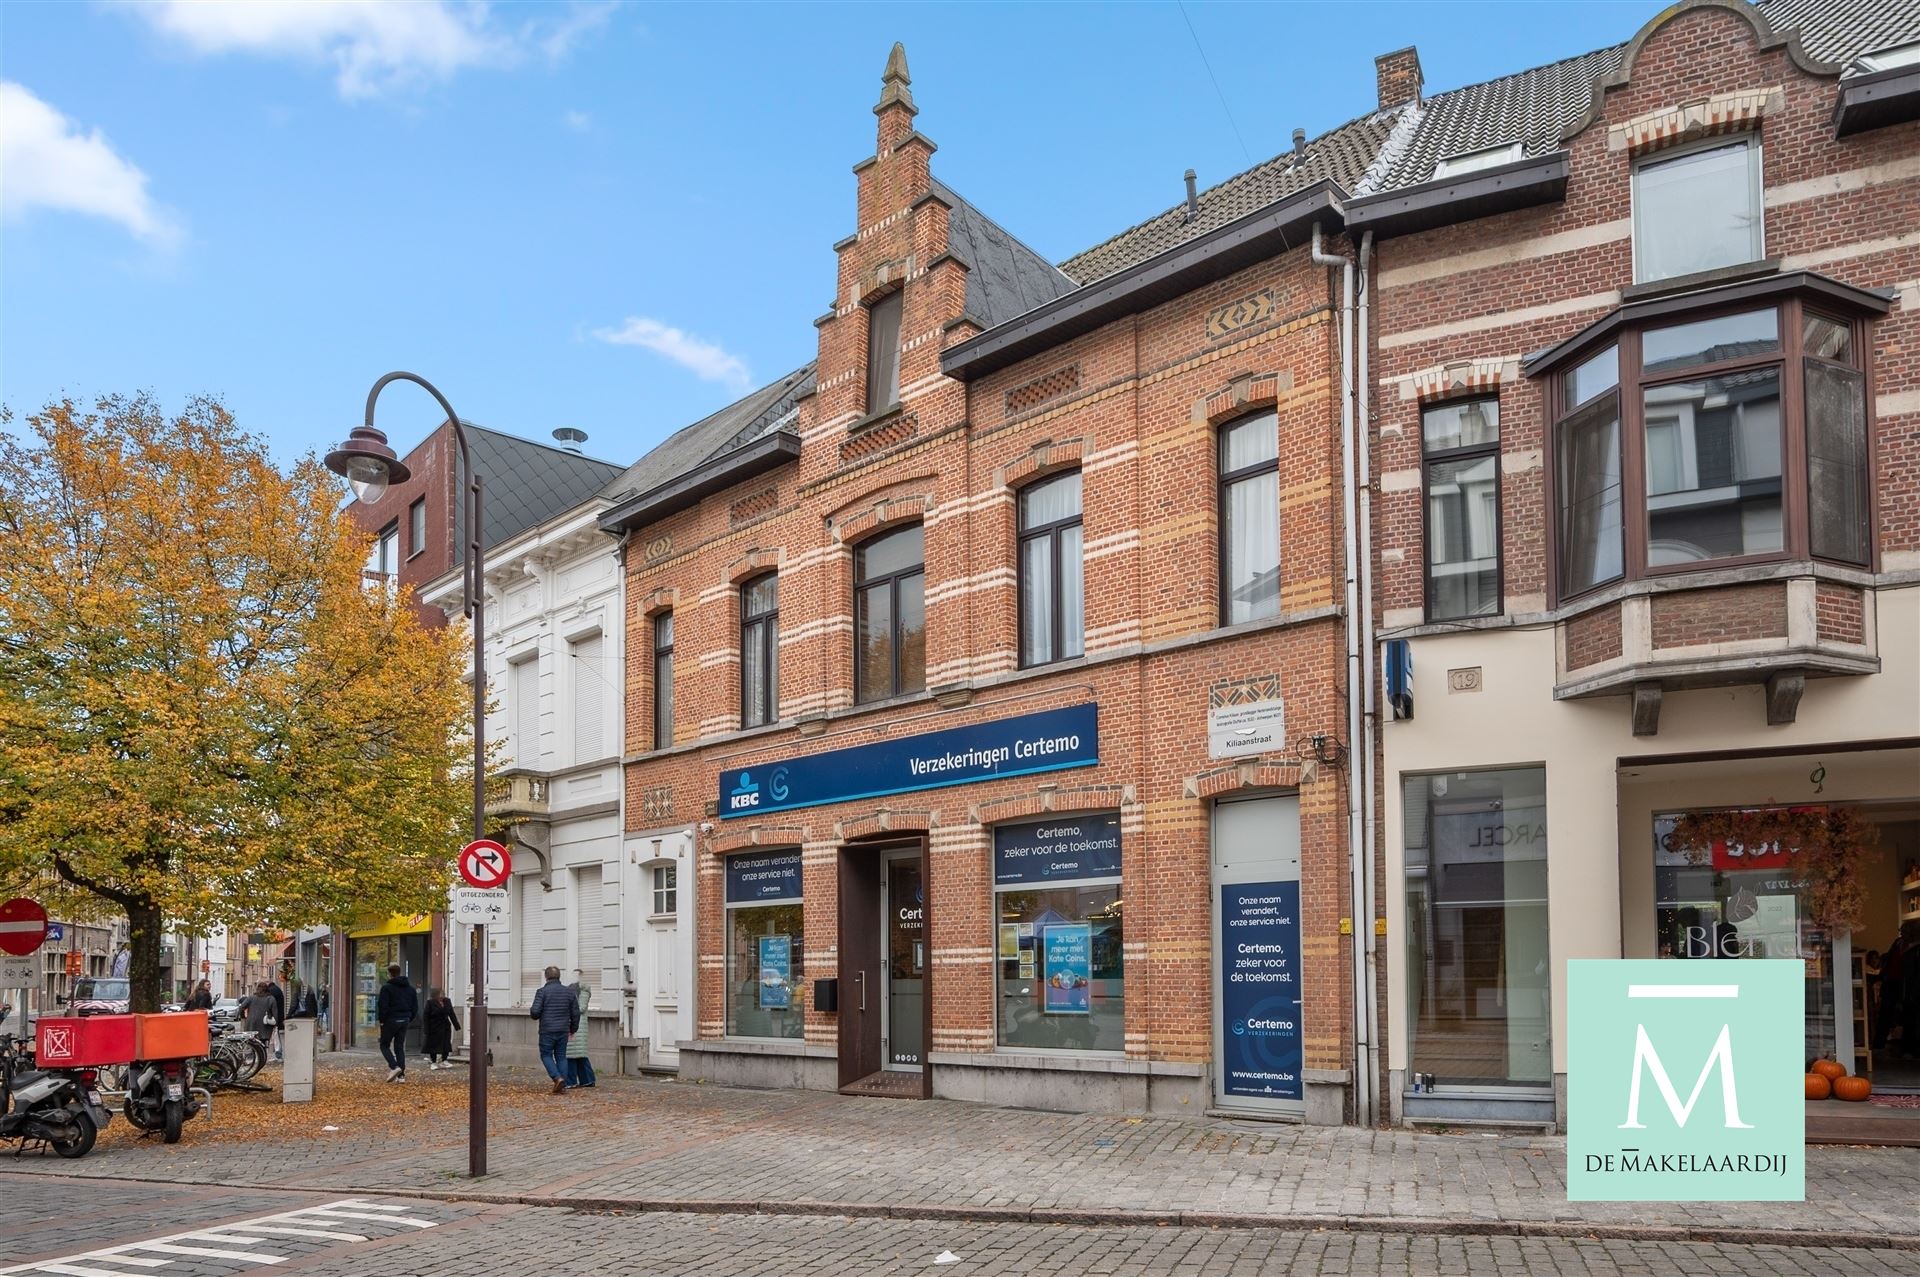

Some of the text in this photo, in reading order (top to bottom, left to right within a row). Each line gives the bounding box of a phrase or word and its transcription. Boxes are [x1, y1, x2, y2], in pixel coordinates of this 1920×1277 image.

[1459, 673, 1474, 688] 19
[1226, 735, 1271, 748] Kiliaanstraat
[910, 735, 1079, 775] Verzekeringen Certemo
[731, 792, 759, 808] KBC
[1037, 827, 1082, 839] Certemo,
[1004, 838, 1118, 858] zeker voor de toekomst.
[734, 860, 750, 869] Onze
[751, 860, 770, 868] naam
[1051, 862, 1078, 870] Certemo
[742, 868, 795, 881] onze service niet.
[1239, 896, 1281, 905] Onze naam
[1241, 907, 1279, 915] verandert,
[1249, 917, 1274, 926] service
[1065, 935, 1078, 943] kan
[1070, 944, 1083, 952] met
[1238, 944, 1283, 954] Certemo,
[1236, 958, 1286, 968] zeker voor
[1231, 972, 1292, 982] de toekomst.
[1248, 1019, 1293, 1029] Certemo
[1232, 1072, 1294, 1080] www.certemo.be
